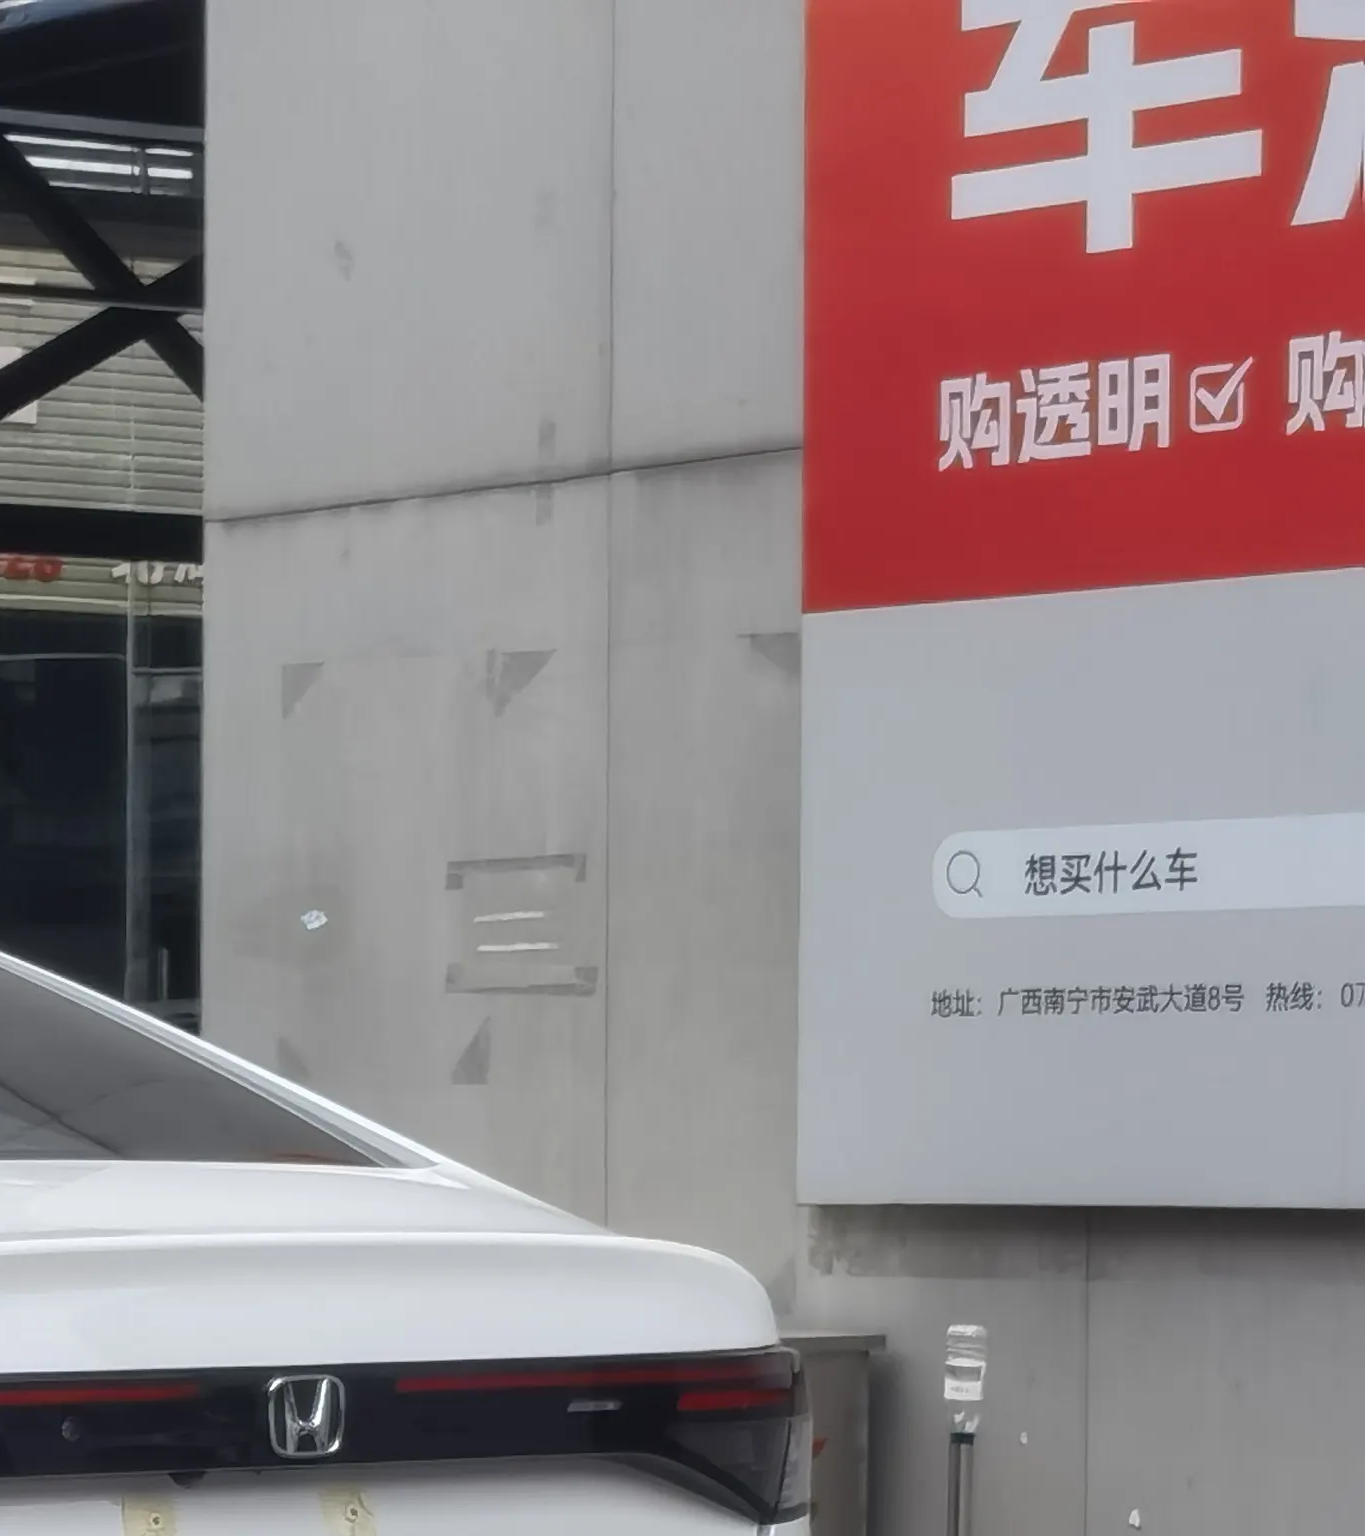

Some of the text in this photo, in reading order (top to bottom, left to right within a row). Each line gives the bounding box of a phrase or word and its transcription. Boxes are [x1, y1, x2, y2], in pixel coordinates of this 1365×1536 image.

[951, 0, 1365, 254] 车
[938, 353, 1170, 471] 购透明
[1024, 847, 1199, 897] 想买什么车
